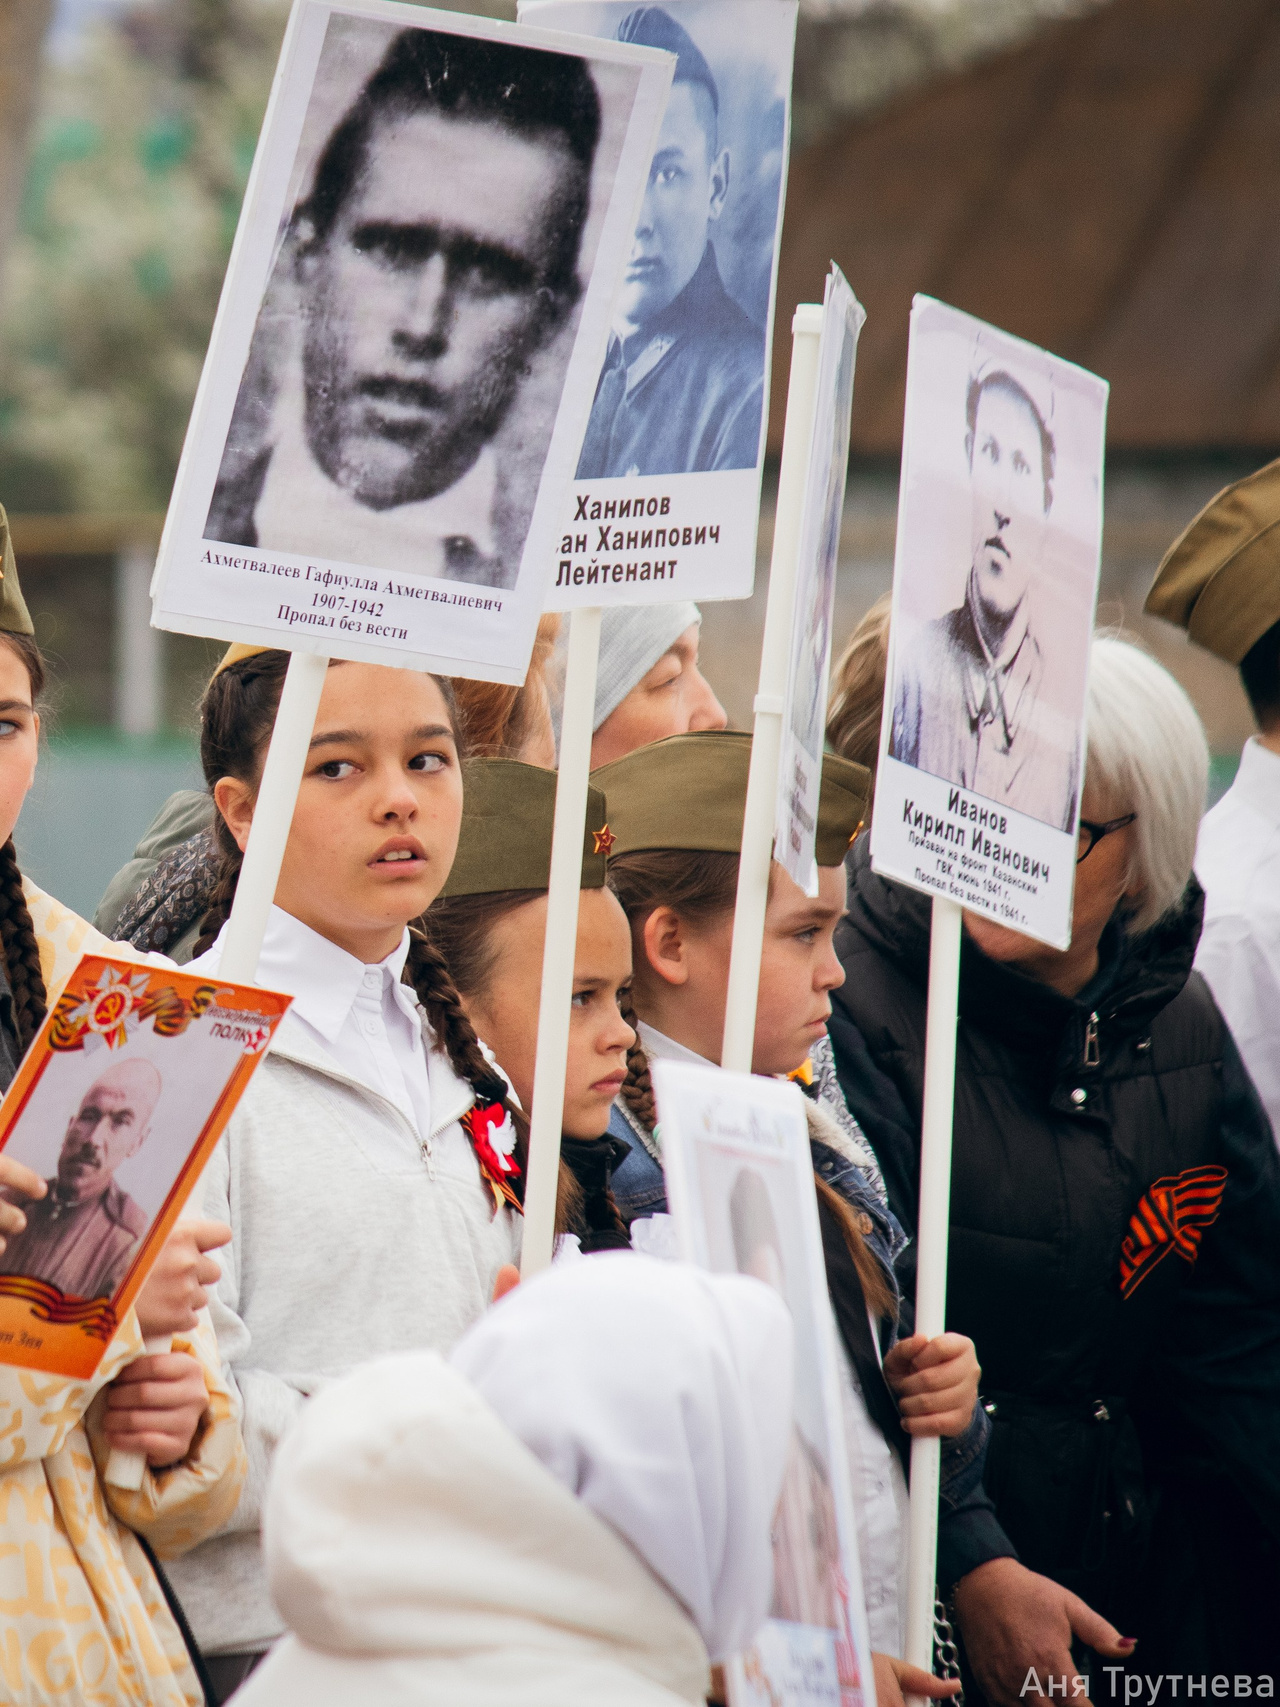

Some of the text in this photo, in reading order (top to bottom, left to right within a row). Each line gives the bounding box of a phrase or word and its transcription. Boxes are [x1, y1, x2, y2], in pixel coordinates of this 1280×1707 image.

[573, 494, 672, 521] Ханипов
[556, 524, 721, 555] ан Ханипович
[201, 549, 504, 612] Ахметвалеев Гафиулла Ахметвалиевич
[555, 558, 678, 587] Лейтенант
[277, 604, 409, 640] Пропал без вести
[311, 592, 384, 618] 1907-1942
[948, 787, 1008, 835] Иванов
[903, 799, 1051, 883] Кирилл Иванович
[909, 830, 946, 856] Призван
[948, 849, 958, 861] на
[961, 852, 987, 873] фронт
[915, 867, 947, 890] Пропал
[949, 881, 965, 898] без
[967, 891, 990, 909] вести
[983, 878, 1001, 897] 1941
